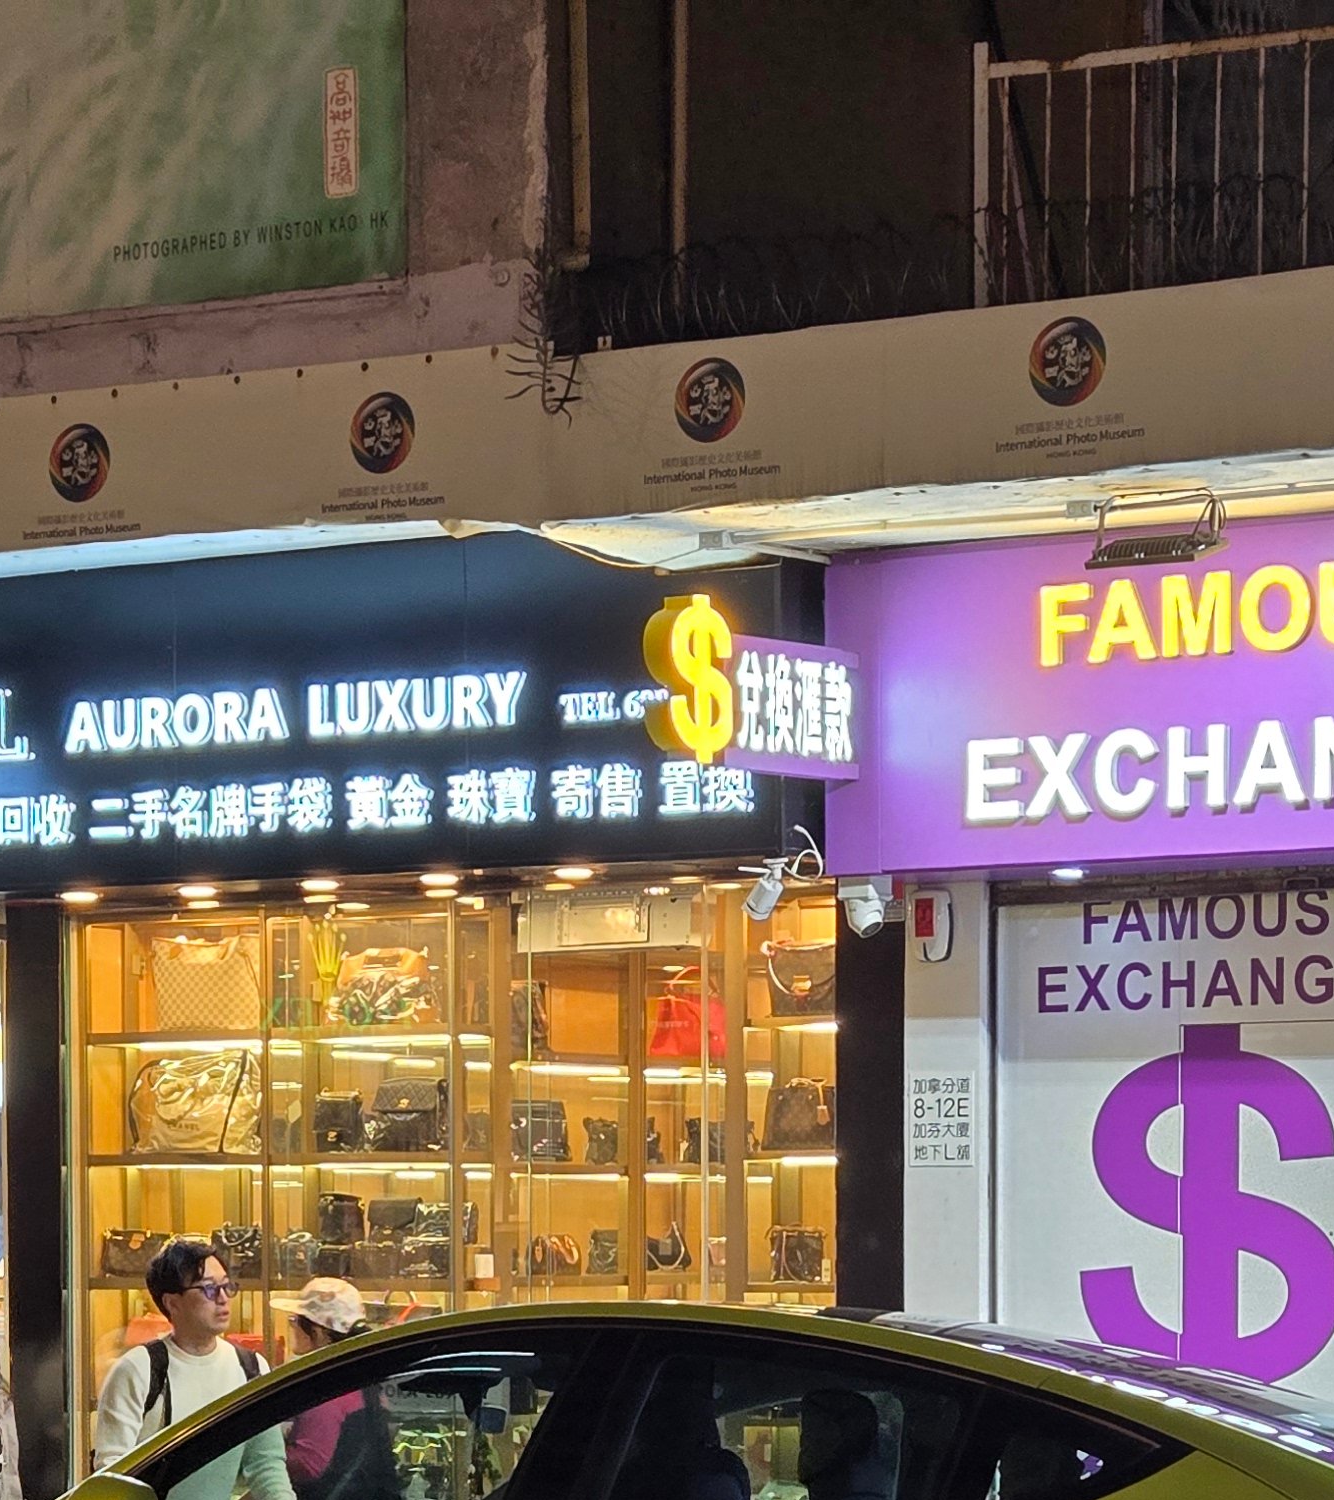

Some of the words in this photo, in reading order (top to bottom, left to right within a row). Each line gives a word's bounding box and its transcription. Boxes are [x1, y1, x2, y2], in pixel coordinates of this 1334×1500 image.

[113, 231, 227, 263] PHOTOGRAPHED
[233, 228, 251, 248] BY
[257, 218, 323, 244] WINSTON
[329, 213, 358, 233] KAO
[369, 210, 389, 229] HK
[996, 435, 1063, 453] International
[1067, 432, 1098, 445] Photo
[1099, 427, 1145, 441] Museum
[643, 469, 705, 485] International
[708, 466, 737, 480] Photo
[739, 464, 781, 477] Museum
[321, 499, 378, 514] International
[381, 498, 407, 509] Photo
[409, 495, 445, 507] Museum
[23, 526, 77, 541] International
[79, 524, 104, 536] Photo
[106, 522, 141, 535] Museum
[66, 688, 289, 753] AURORA
[309, 671, 526, 739] LUXURY
[88, 776, 332, 840] 二手名牌手袋
[448, 767, 536, 824] 珠寶
[551, 762, 643, 819] 寄售
[659, 761, 755, 816] 置換
[1081, 888, 1331, 945] FAMOUS
[913, 1077, 970, 1094] 加拿分道
[913, 1097, 970, 1118] 8-12E
